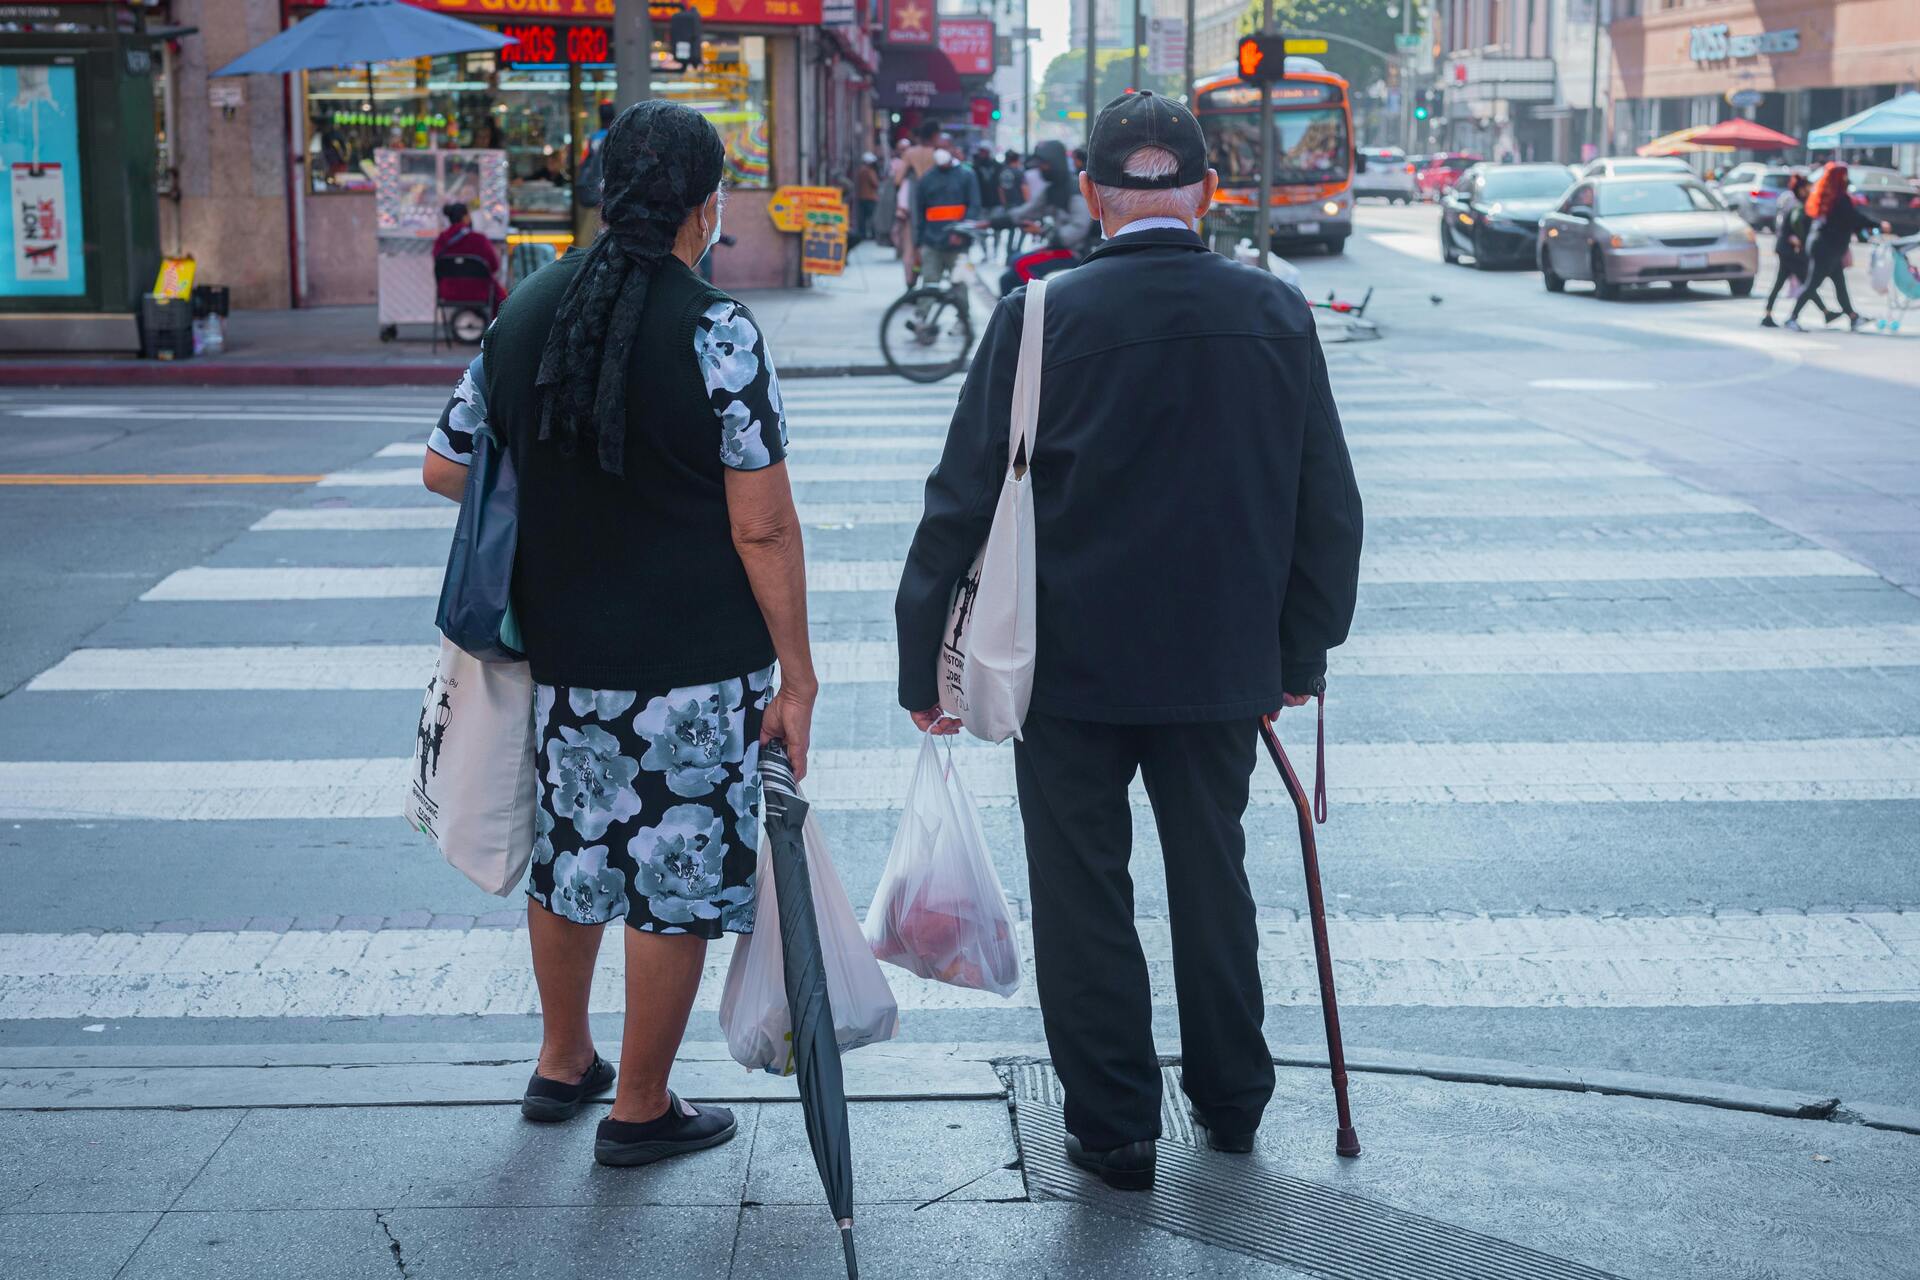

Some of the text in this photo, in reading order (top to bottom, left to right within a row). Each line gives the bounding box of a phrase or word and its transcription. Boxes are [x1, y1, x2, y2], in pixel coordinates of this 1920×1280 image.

[0, 7, 59, 17] OWNTOWN
[896, 81, 937, 95] HOTEL
[22, 202, 37, 239] NOT
[38, 198, 55, 240] MILK
